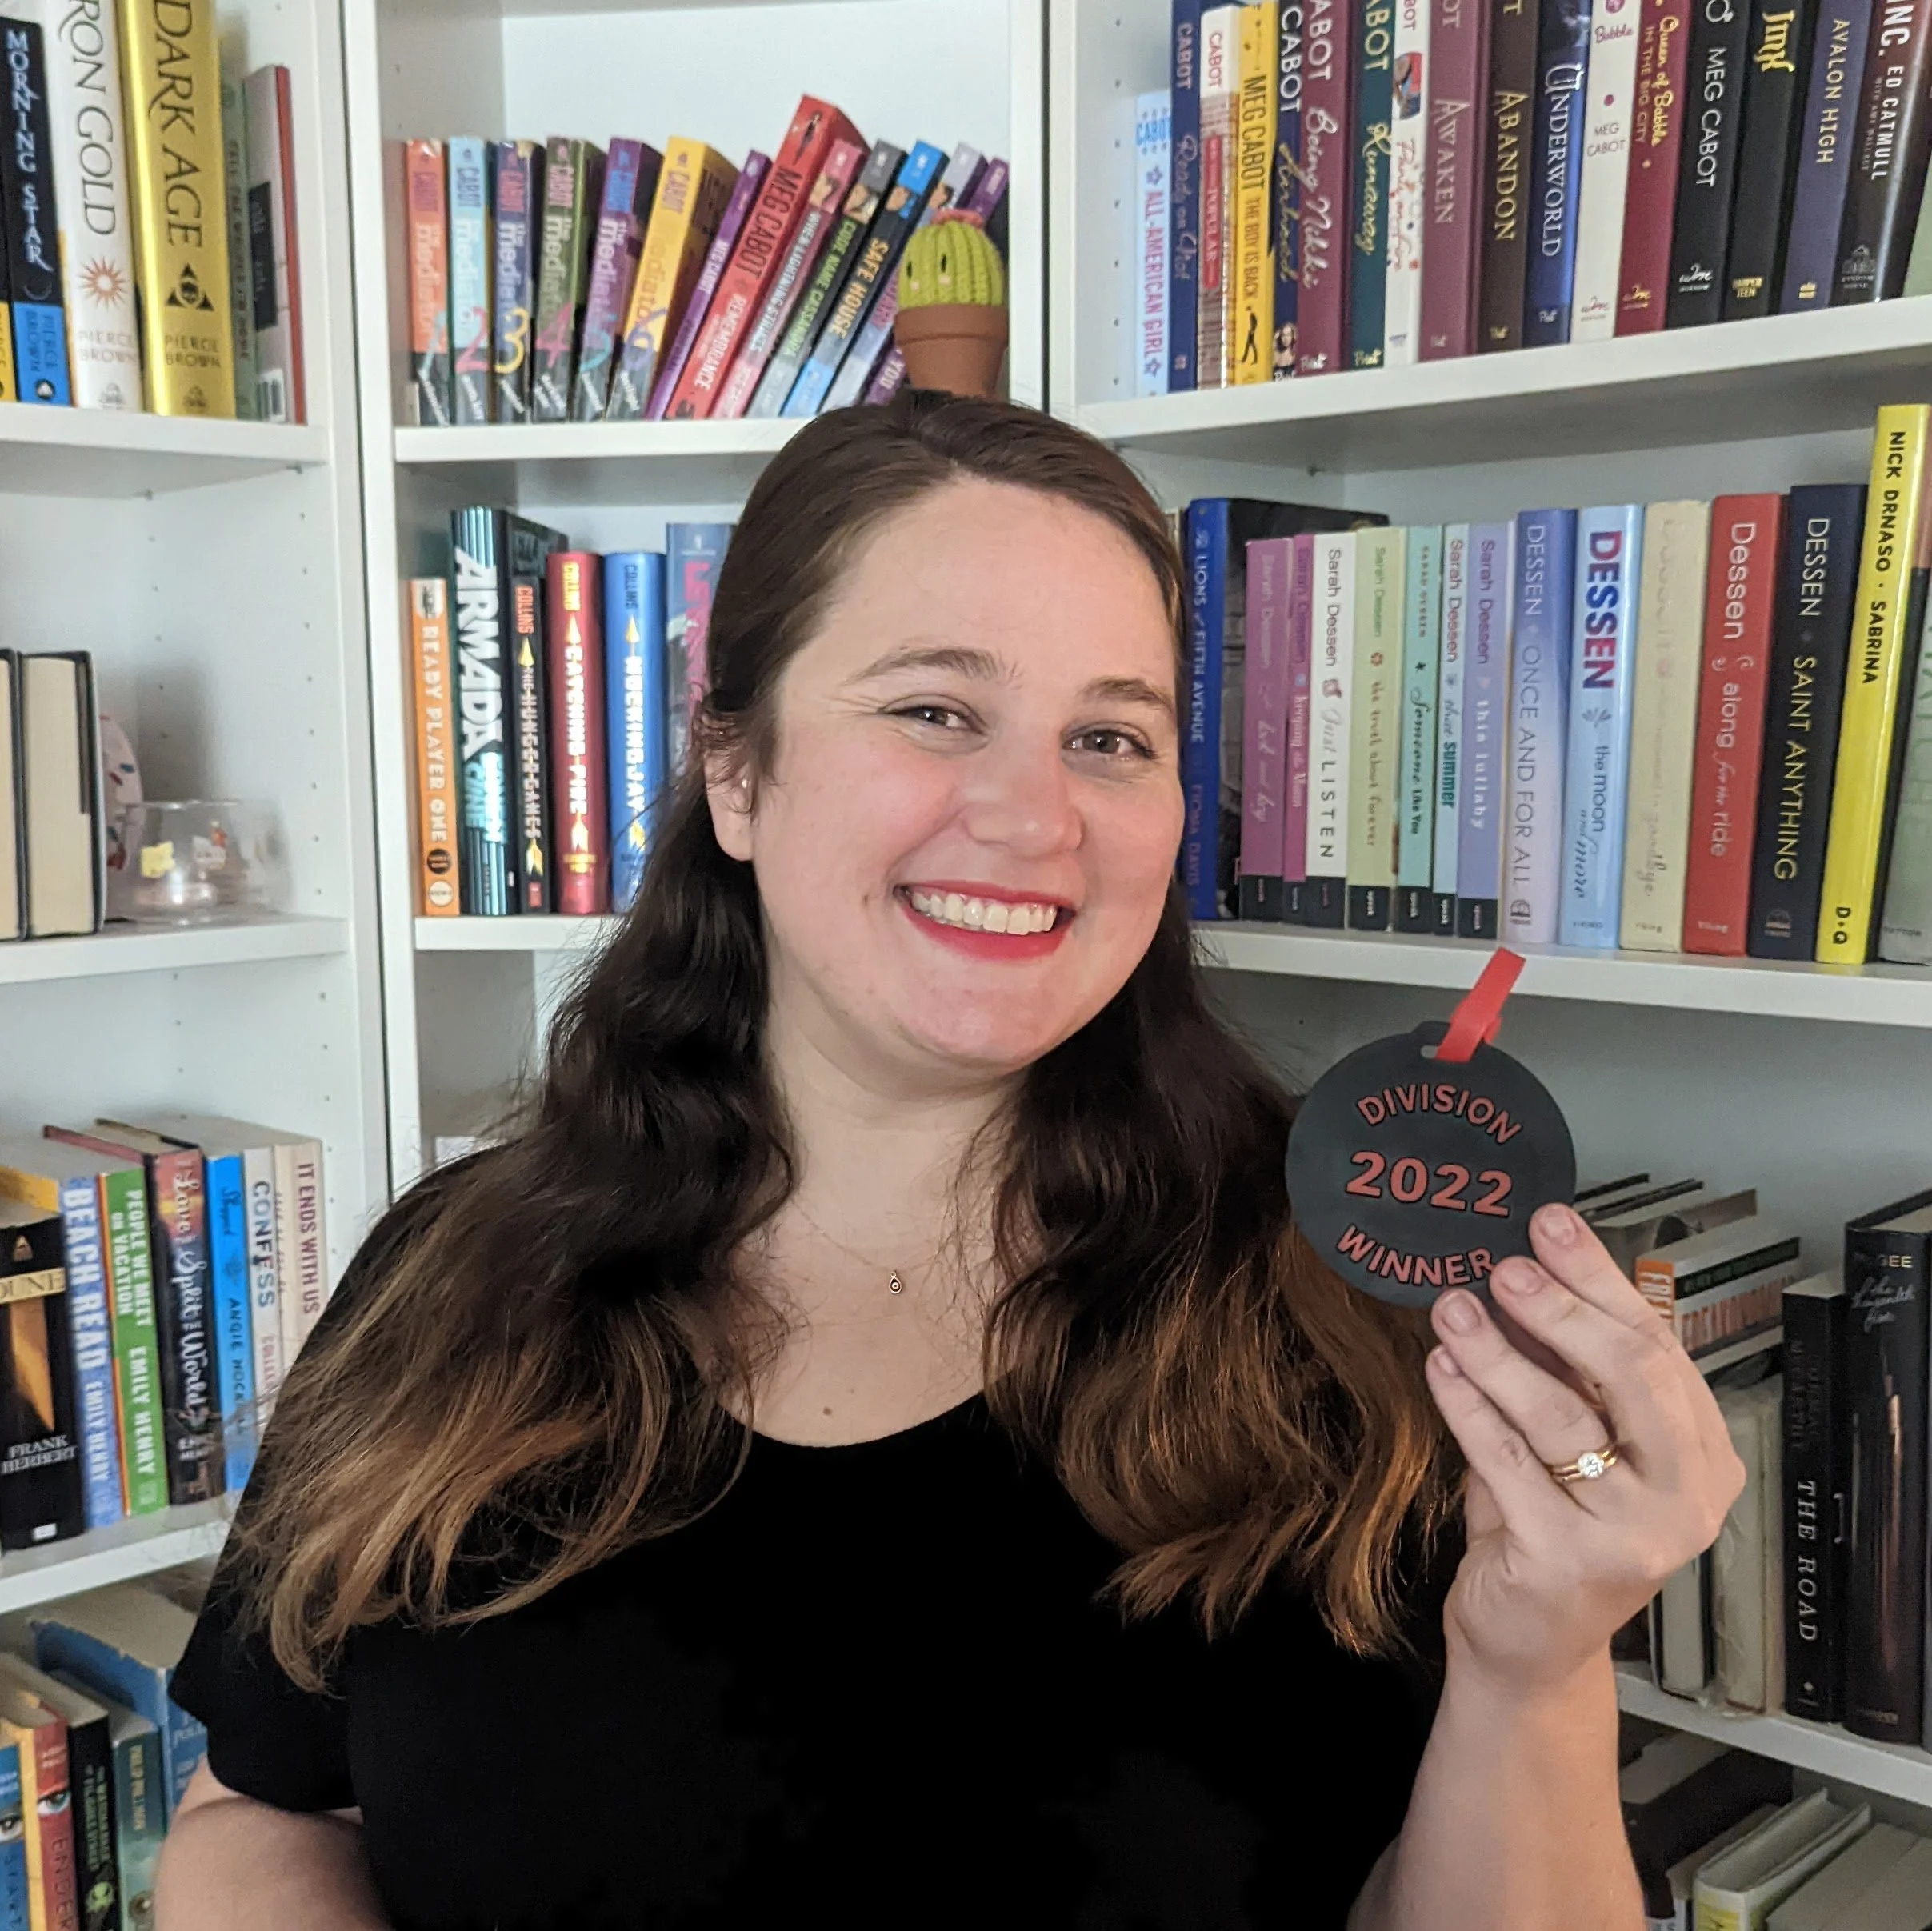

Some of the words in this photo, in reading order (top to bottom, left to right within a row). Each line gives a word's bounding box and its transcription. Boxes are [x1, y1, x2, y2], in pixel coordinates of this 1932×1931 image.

[1176, 22, 1193, 89] CABOT
[1207, 32, 1224, 88] CABOT
[1281, 8, 1302, 113] CABOT
[1594, 25, 1634, 45] Babble
[1658, 16, 1678, 68] Queen
[1825, 19, 1850, 100] AVALON
[148, 0, 195, 135] DARK
[1705, 47, 1726, 101] MEG
[1886, 66, 1903, 88] ED
[6, 30, 39, 172] MORNING
[1243, 75, 1266, 123] MEG
[1651, 90, 1674, 147] Babble
[1240, 126, 1266, 191] CABOT
[1305, 106, 1338, 191] Being
[1587, 139, 1626, 158] CABOT
[1594, 122, 1620, 137] MEG
[1697, 110, 1721, 186] CABOT
[1817, 108, 1839, 163] HIGH
[1870, 98, 1898, 181] CATMULL
[77, 106, 116, 235] GOLD
[762, 166, 802, 213] MEG
[1356, 123, 1392, 254] Runaway
[1434, 99, 1471, 224] AWAKEN
[1494, 90, 1530, 241] ABANDON
[1542, 64, 1585, 257] UNDERWORLD
[162, 143, 202, 248] AGE
[1205, 187, 1220, 262] POPULAR
[1245, 198, 1260, 218] THE
[22, 187, 54, 271] STAR
[736, 213, 782, 278] CABOT
[832, 218, 858, 255] CODE
[1145, 190, 1162, 315] ALL-AMERICAN
[1244, 222, 1259, 247] BOY
[1244, 250, 1258, 265] IS
[1302, 198, 1333, 289] Nikki
[815, 254, 840, 290] NAME
[857, 238, 890, 282] SAFE
[1243, 266, 1258, 299] BACK
[455, 307, 490, 372] 2
[494, 308, 529, 373] 3
[535, 302, 573, 367] 4
[782, 288, 824, 357] CASSANDRA
[827, 282, 868, 340] HOUSE
[1144, 319, 1162, 358] GIRL
[165, 334, 218, 352] PIERCE
[166, 350, 222, 368] BROWN
[694, 294, 746, 390] REMEMBRANCE
[880, 359, 905, 390] YOU
[1886, 431, 1906, 480] NICK
[1876, 489, 1901, 572] DRNASO
[562, 562, 582, 611] COLLINS
[626, 565, 639, 610] COLLINS
[1192, 554, 1208, 606] LIONS
[1327, 548, 1342, 598] Sarah
[1374, 546, 1386, 584] Sarah
[1448, 539, 1463, 590] Sarah
[1478, 539, 1495, 591] Sarah
[1523, 525, 1546, 615] DESSEN
[1723, 522, 1756, 639] Dessen
[1799, 518, 1830, 618] DESSEN
[515, 585, 534, 634] COLLINS
[1325, 603, 1342, 667] Dessen
[1372, 589, 1386, 638] Dessen
[1445, 596, 1462, 663] Dessen
[1477, 598, 1494, 665] Dessen
[1582, 530, 1622, 690] DESSEN
[421, 626, 441, 697] READY
[454, 546, 502, 761] ARMADA
[1191, 629, 1207, 676] FIFTH
[1862, 600, 1886, 684] SABRINA
[566, 645, 586, 755] CATCHING
[1190, 680, 1206, 744] AVENUE
[1371, 681, 1385, 706] the
[1520, 645, 1542, 719] ONCE
[1791, 656, 1817, 732] SAINT
[520, 694, 539, 774] HUNGER
[625, 656, 644, 812] MOCKINGJAY
[1370, 710, 1383, 747] truth
[1410, 686, 1431, 785] Someone
[1476, 699, 1490, 742] this
[1715, 682, 1740, 748] along
[426, 702, 444, 791] PLAYER
[1367, 752, 1382, 788] about
[1440, 741, 1458, 809] summer
[1517, 727, 1537, 782] AND
[1594, 745, 1610, 771] the
[523, 776, 542, 839] GAMES
[569, 764, 587, 815] FIRE
[1320, 761, 1336, 858] LISTEN
[1410, 789, 1423, 812] Like
[1470, 750, 1490, 830] lullaby
[1514, 790, 1535, 837] FOR
[1591, 774, 1607, 833] moon
[1774, 740, 1807, 881] ANYTHING
[430, 799, 447, 844] ONE
[1365, 794, 1381, 847] forever
[1409, 814, 1422, 835] You
[1710, 810, 1733, 857] ride
[1512, 846, 1533, 887] ALL
[1573, 836, 1600, 899] more
[1357, 1083, 1522, 1144] DIVISION
[298, 1163, 314, 1180] IT
[1346, 1150, 1513, 1217] 2022
[126, 1189, 147, 1248] PEOPLE
[171, 1173, 200, 1234] Love
[299, 1185, 317, 1234] ENDS
[62, 1188, 102, 1288] BEACH
[133, 1253, 150, 1279] WE
[251, 1181, 275, 1309] CONFESS
[301, 1237, 319, 1285] WITH
[1337, 1224, 1494, 1286] WINNER
[113, 1233, 134, 1316] VACATION
[134, 1282, 152, 1327] MEET
[170, 1249, 204, 1318] Split
[303, 1290, 320, 1315] US
[70, 1291, 107, 1370] READ
[228, 1297, 244, 1350] ANGIE
[85, 1381, 106, 1430] EMILY
[128, 1347, 152, 1404] EMILY
[1, 1445, 78, 1474] HERBERT
[8, 1434, 69, 1458] FRANK
[87, 1433, 110, 1481] HENRY
[133, 1410, 155, 1475] HENRY
[1797, 1480, 1816, 1540] THE
[1797, 1557, 1818, 1642] ROAD
